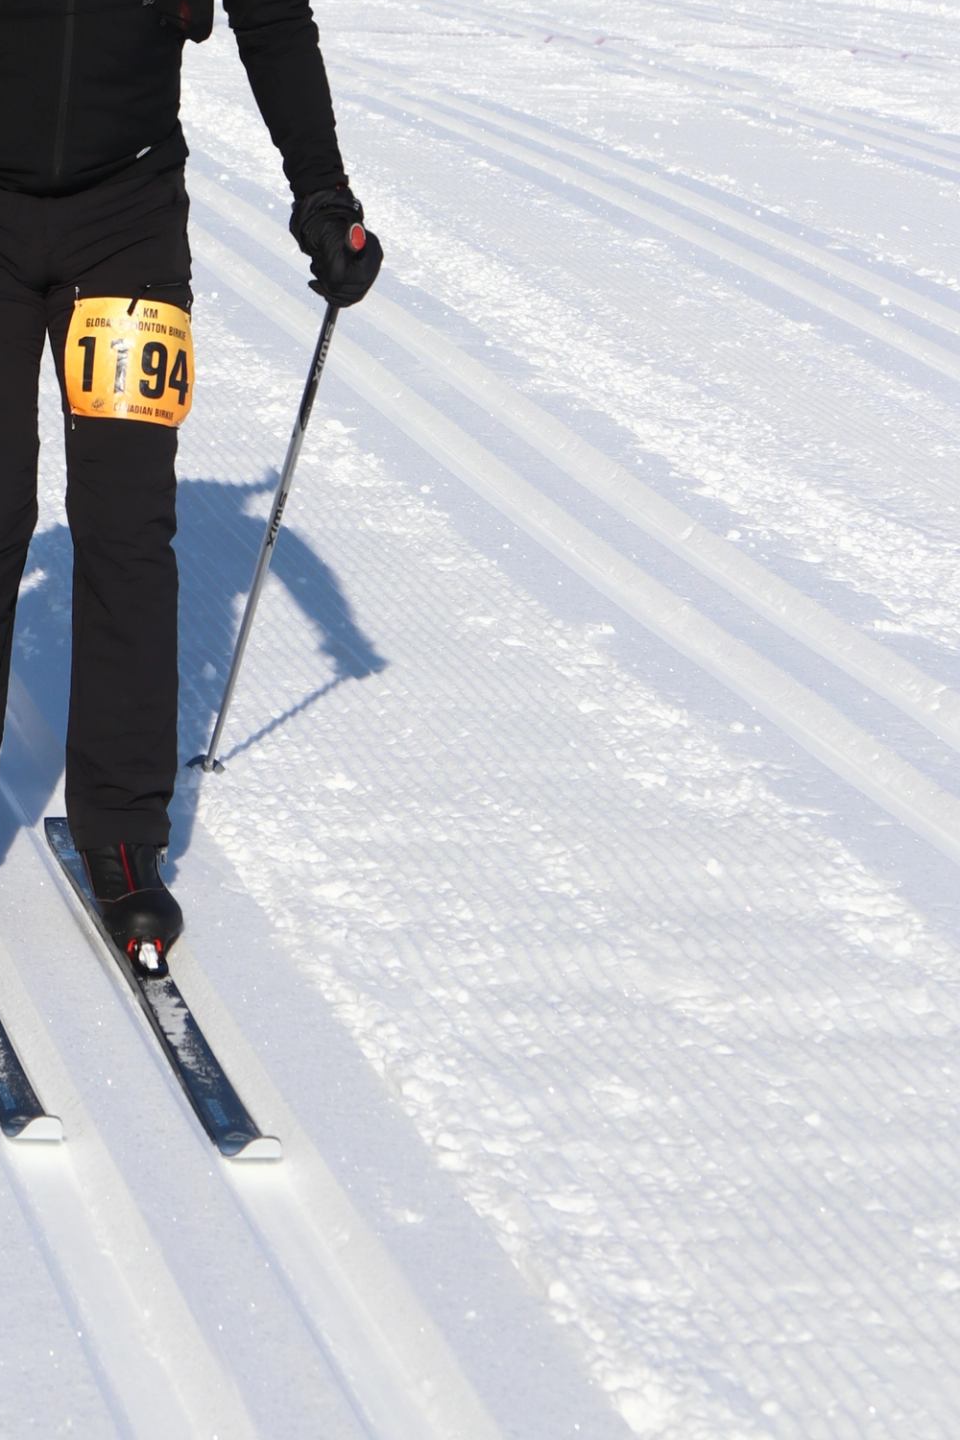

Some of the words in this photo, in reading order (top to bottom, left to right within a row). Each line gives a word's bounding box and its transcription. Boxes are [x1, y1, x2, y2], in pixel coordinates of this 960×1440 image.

[143, 307, 158, 319] KM
[86, 317, 113, 328] GLOBA
[78, 335, 189, 406] 1194
